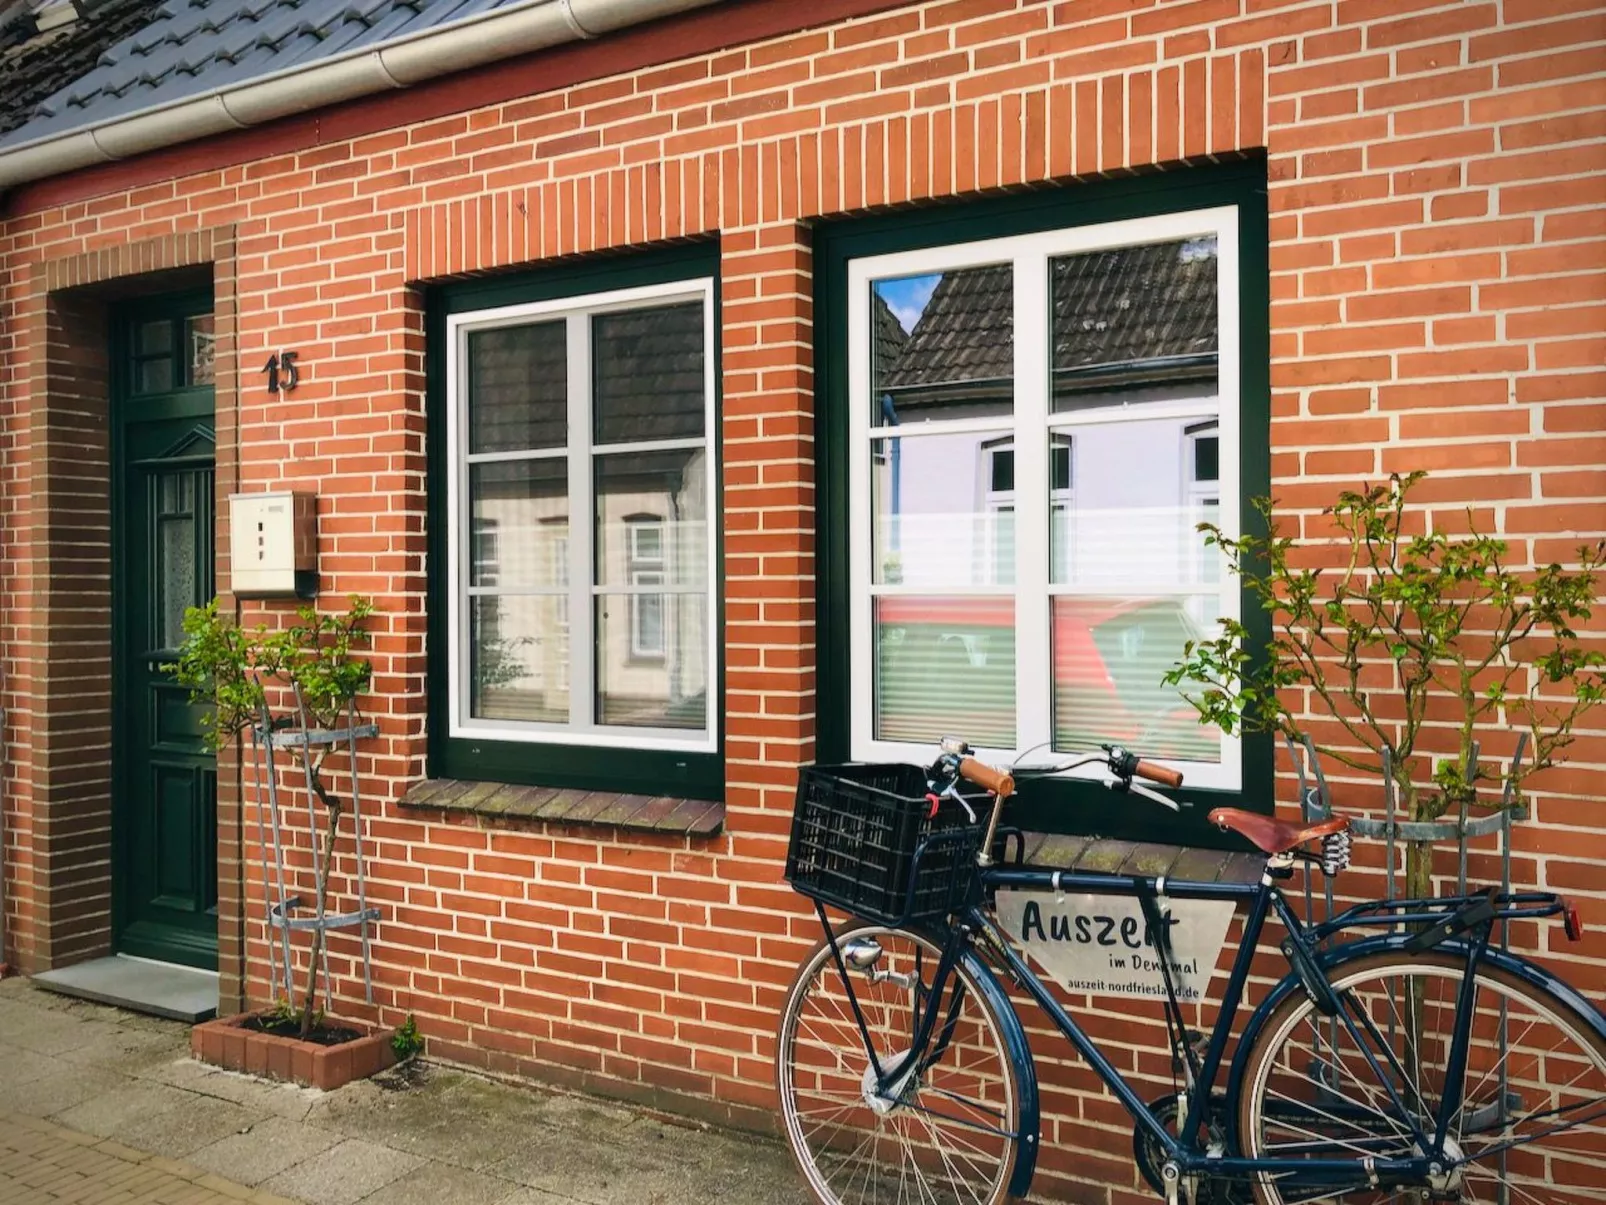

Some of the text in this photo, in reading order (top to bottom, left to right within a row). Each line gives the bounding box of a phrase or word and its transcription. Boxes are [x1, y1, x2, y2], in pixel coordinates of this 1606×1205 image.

[261, 351, 299, 393] 15
[1109, 953, 1198, 975] im Denmal
[1067, 979, 1199, 998] auszeit-nordfrieslad.de
